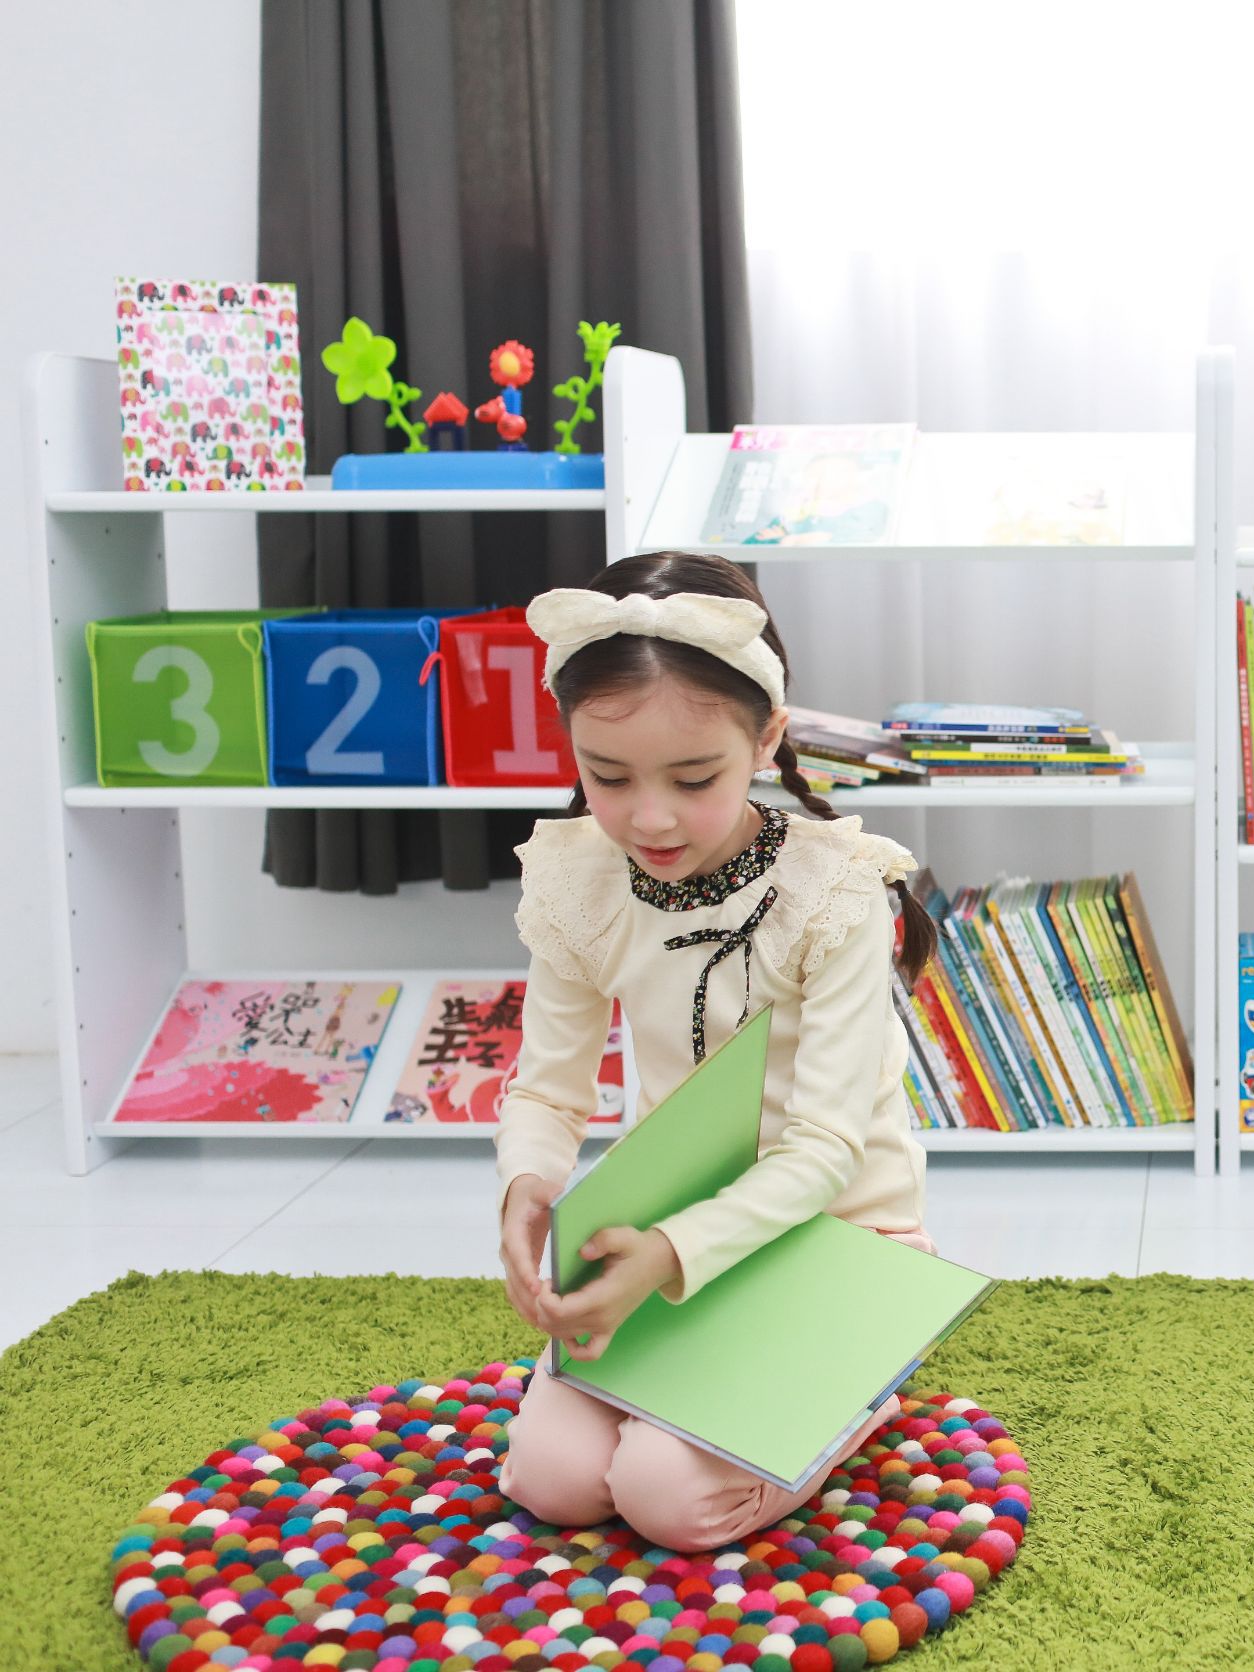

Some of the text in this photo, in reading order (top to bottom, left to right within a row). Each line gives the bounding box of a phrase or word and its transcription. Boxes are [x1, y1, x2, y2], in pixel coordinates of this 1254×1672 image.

[132, 646, 220, 777] 3
[306, 646, 384, 775] 2
[487, 646, 559, 775] 1
